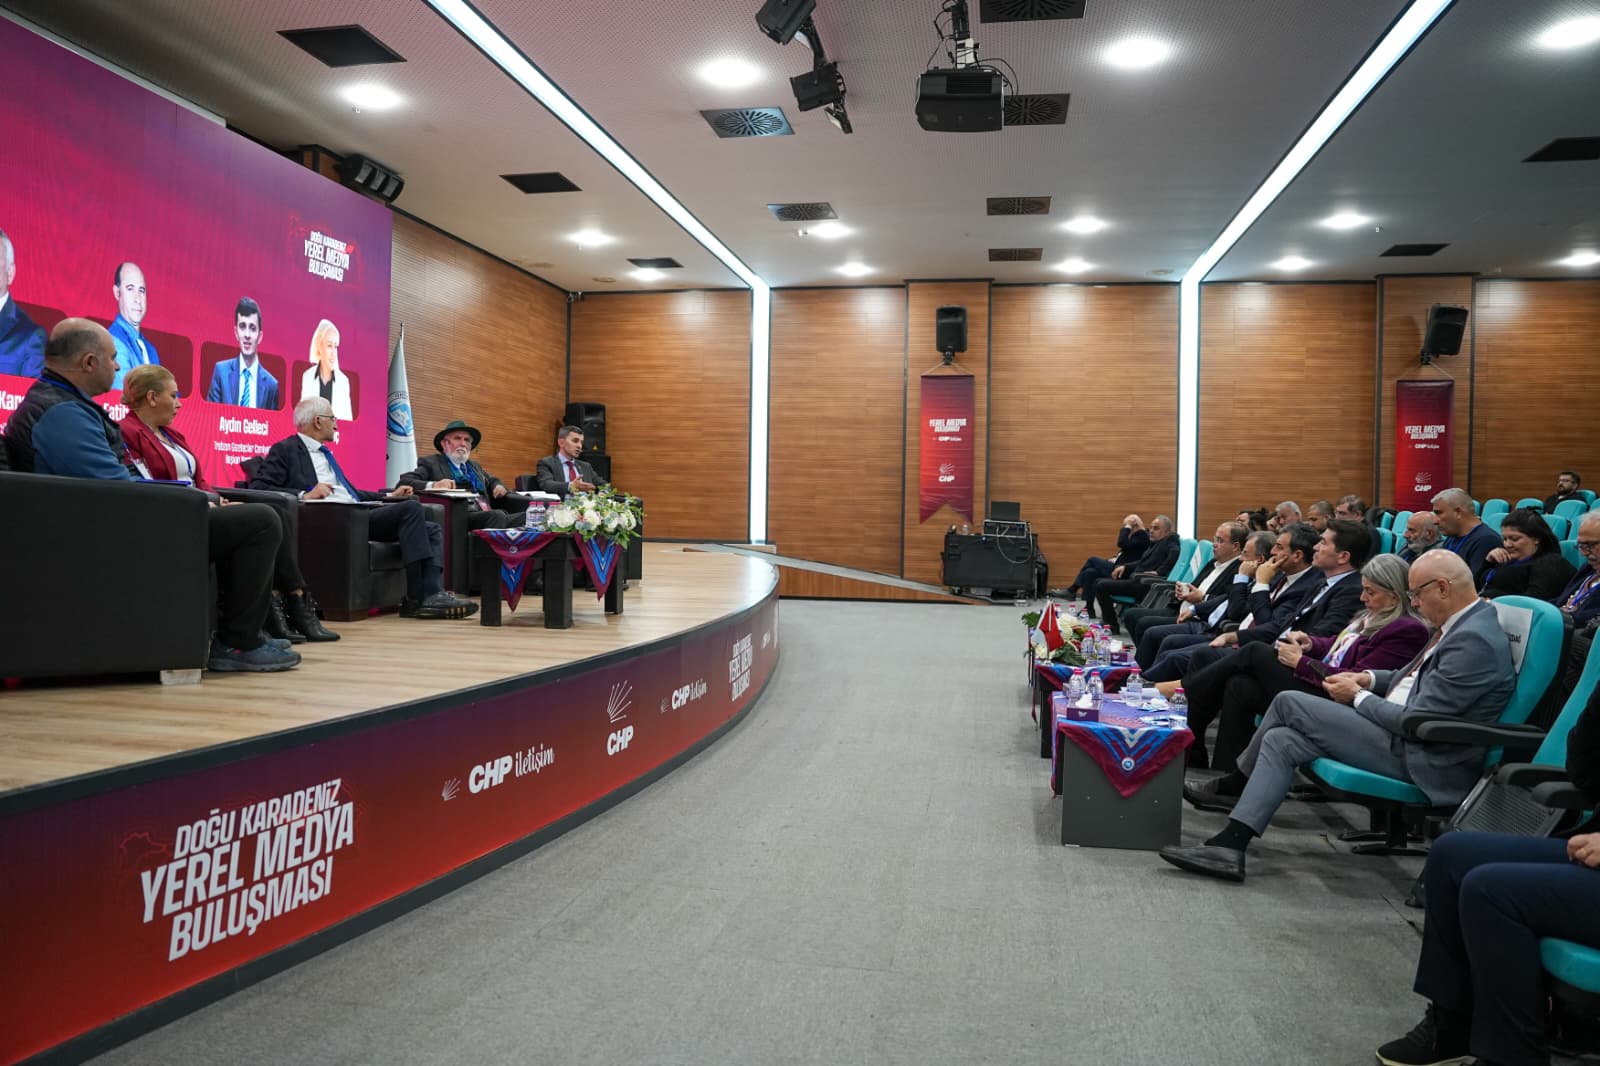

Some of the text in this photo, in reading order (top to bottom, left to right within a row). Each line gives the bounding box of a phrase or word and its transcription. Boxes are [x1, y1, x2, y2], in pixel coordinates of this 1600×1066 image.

[304, 239, 350, 271] YEREL MEDYA
[308, 259, 344, 282] BULUŞMASI
[1404, 424, 1446, 434] YEREL MEDYA
[671, 684, 690, 710] CHP
[607, 725, 634, 756] CHP
[468, 743, 555, 794] CHP iletişim
[173, 808, 236, 860] DOĞU
[141, 802, 354, 924] YEREL MEDYA
[168, 855, 334, 962] BULUŞMASI
